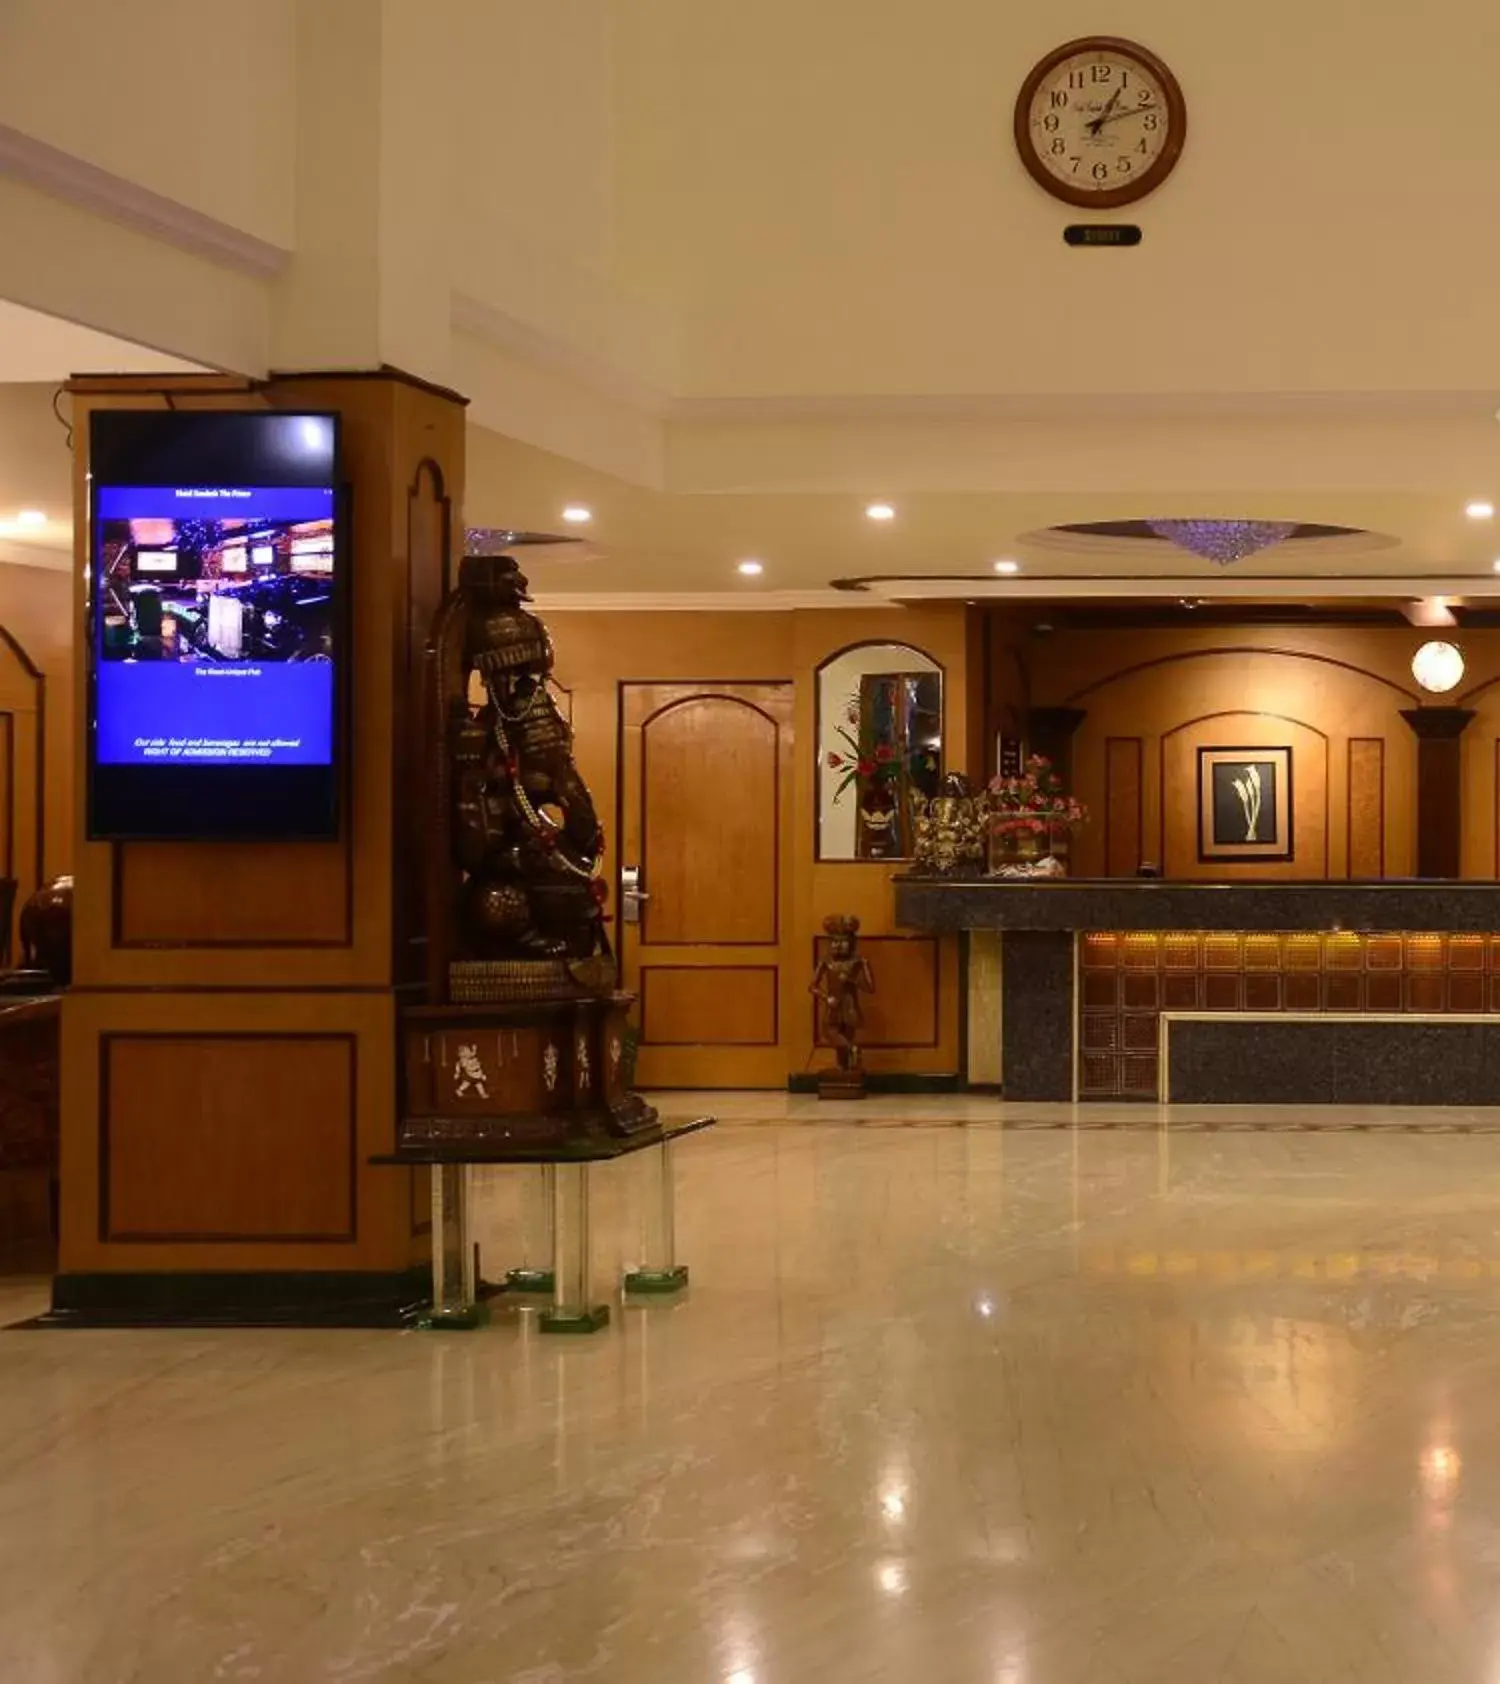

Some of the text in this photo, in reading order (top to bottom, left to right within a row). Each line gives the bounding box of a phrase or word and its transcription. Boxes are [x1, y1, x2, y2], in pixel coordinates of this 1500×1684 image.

[1068, 72, 1083, 88] 11
[1091, 66, 1111, 82] 12
[1121, 72, 1127, 88] 1
[1051, 91, 1067, 108] 10
[1138, 90, 1151, 107] 2
[1044, 115, 1059, 131] 9
[1144, 115, 1157, 130] 3
[1052, 138, 1065, 154] 8
[1135, 138, 1146, 154] 4
[1070, 157, 1081, 173] 7
[1092, 163, 1107, 179] 6
[1117, 157, 1130, 172] 5
